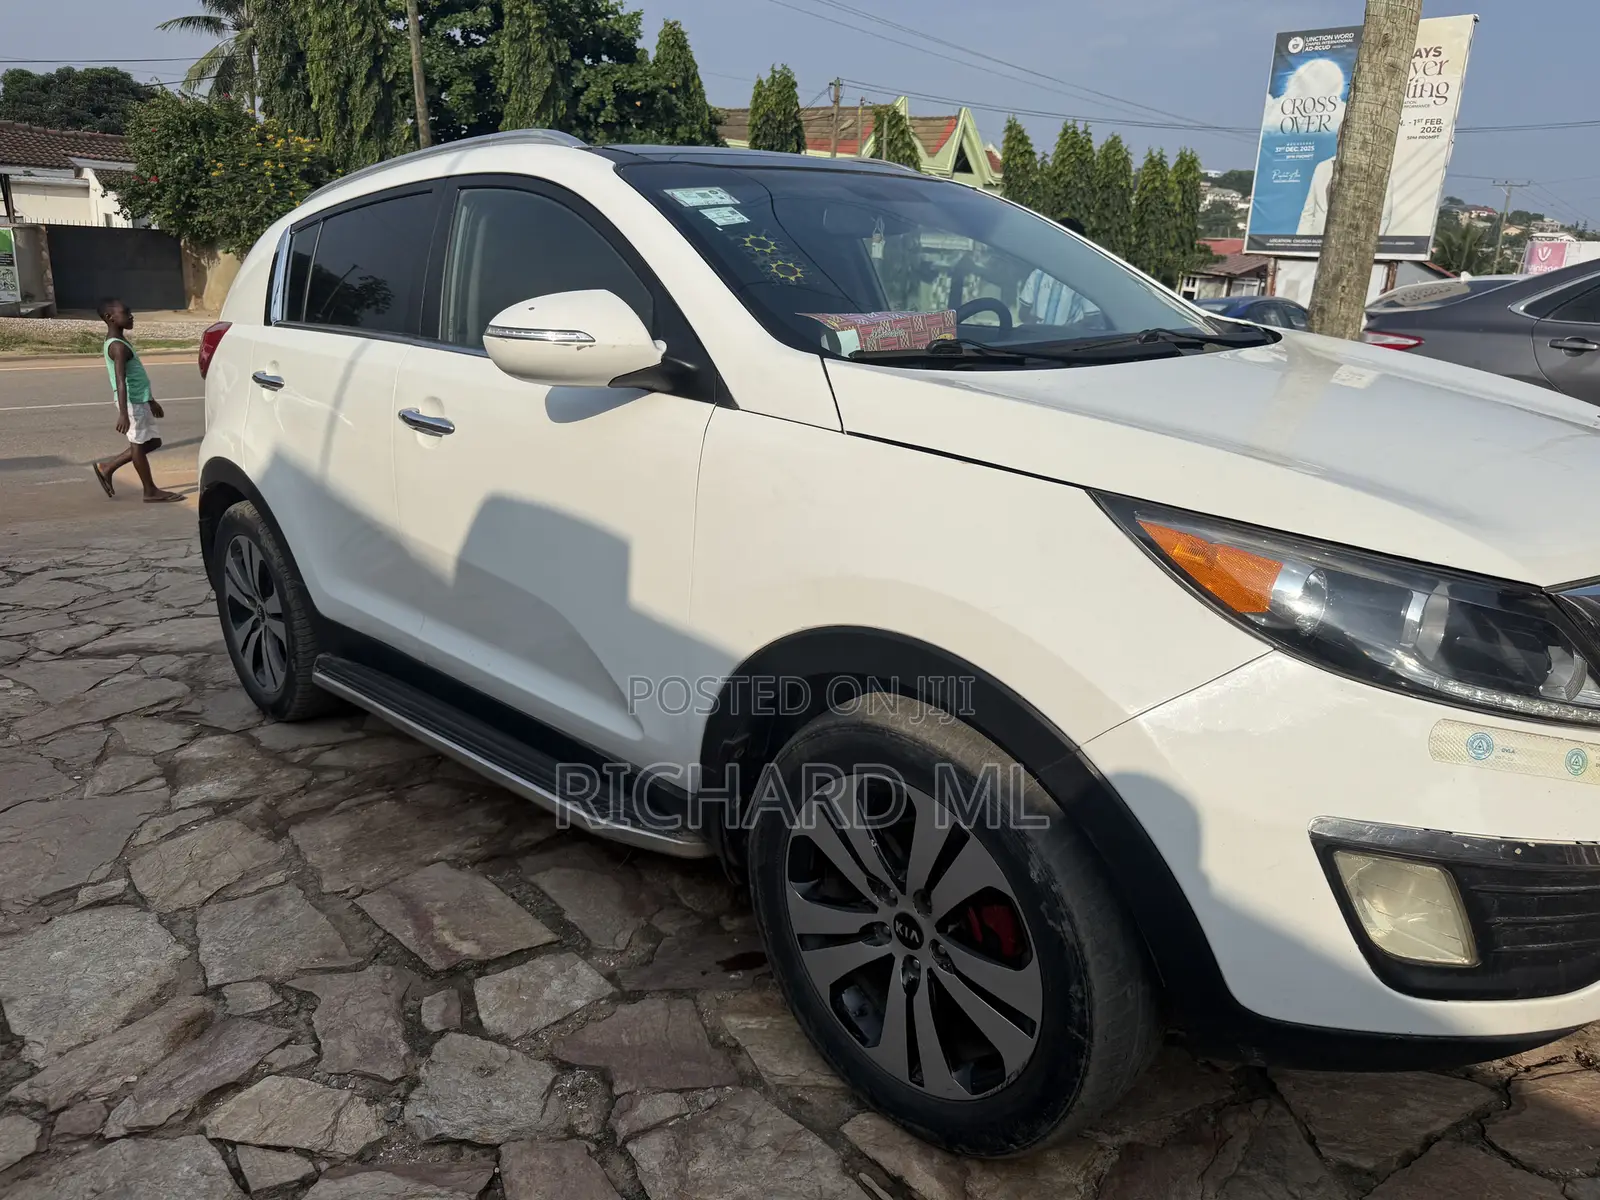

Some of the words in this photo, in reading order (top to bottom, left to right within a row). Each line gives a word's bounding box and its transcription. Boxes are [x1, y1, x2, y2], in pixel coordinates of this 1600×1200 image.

[1412, 46, 1442, 58] AYS
[1409, 60, 1449, 81] yer
[1406, 77, 1449, 106] ting
[1281, 95, 1338, 118] CROSS
[1280, 114, 1332, 134] OVER
[1420, 126, 1442, 134] 2026
[1424, 118, 1443, 126] FEB.
[895, 920, 920, 943] KIA
